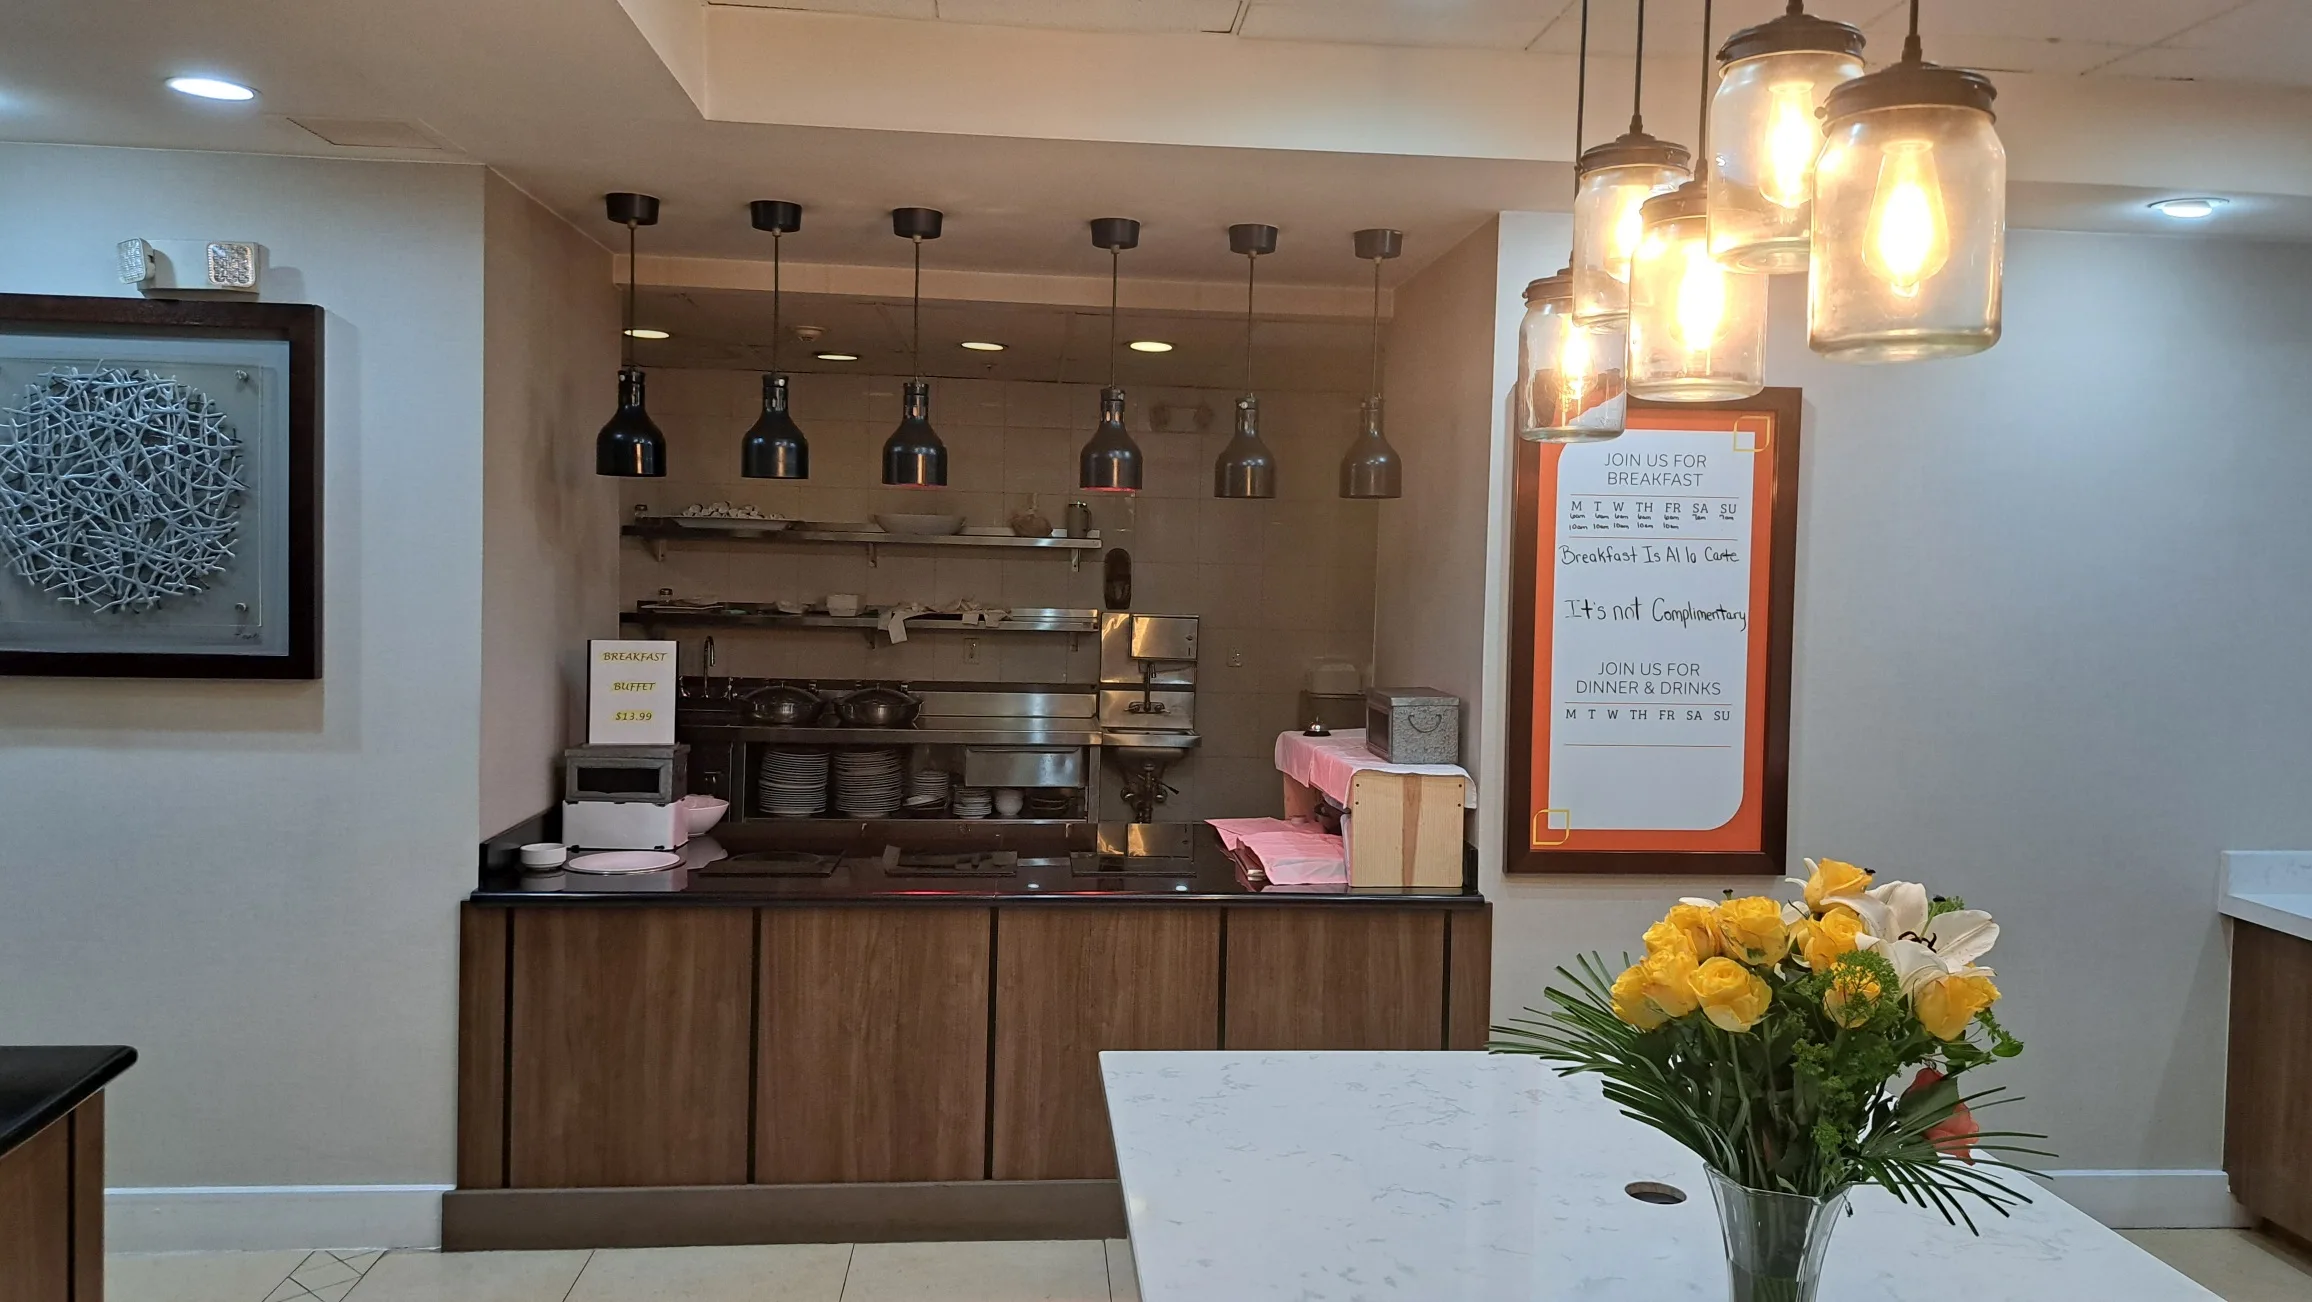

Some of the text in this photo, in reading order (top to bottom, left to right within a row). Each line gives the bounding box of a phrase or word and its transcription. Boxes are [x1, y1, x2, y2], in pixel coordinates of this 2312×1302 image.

[1604, 453, 1707, 468] JOIN US FOR
[1607, 471, 1703, 487] BREAKFAST
[1571, 501, 1737, 514] M T W TH FR SA SU
[1558, 545, 1638, 565] Breakfast
[1641, 546, 1661, 564] Is
[1564, 596, 1747, 632] It's not Complimentary
[603, 652, 667, 662] BREAKFAST
[1598, 661, 1700, 677] JOIN US FOR
[613, 682, 656, 692] BUFFET
[1576, 680, 1721, 695] DINNER & DRINKS
[615, 712, 652, 721] $13.99
[1565, 709, 1730, 721] M T W TH FR SA SU
